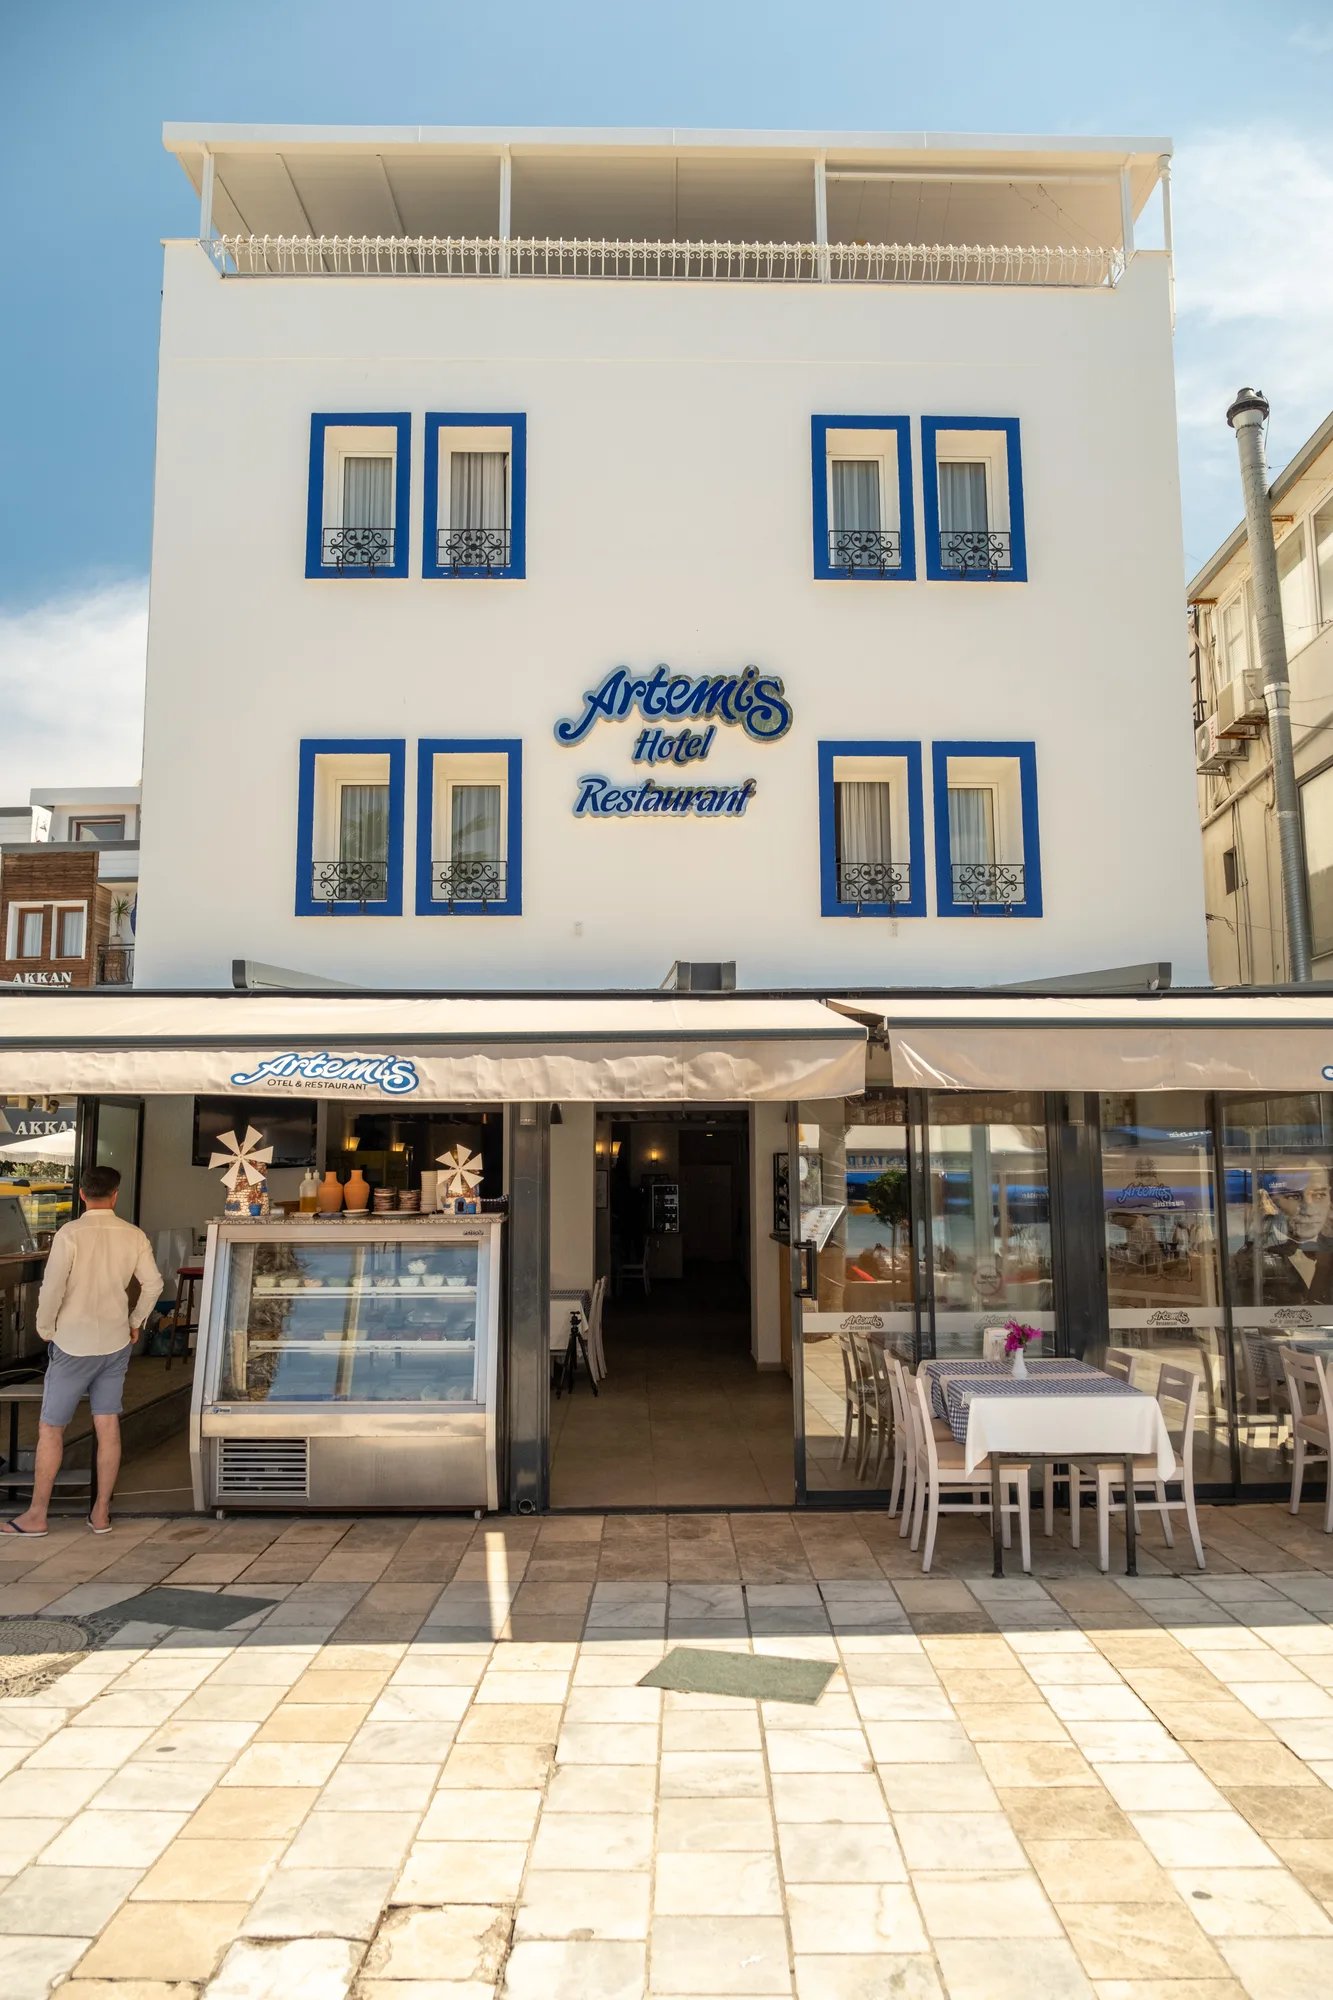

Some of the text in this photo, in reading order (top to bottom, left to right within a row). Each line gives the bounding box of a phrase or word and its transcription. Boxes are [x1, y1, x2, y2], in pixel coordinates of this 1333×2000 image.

[556, 664, 791, 741] Artemis
[633, 724, 716, 763] Hotel
[575, 778, 756, 814] Restaurant
[12, 971, 73, 984] AKKAN
[231, 1052, 419, 1094] Artemis
[267, 1078, 368, 1091] OTEL & RESTAURANT
[1117, 1182, 1173, 1204] Artemis
[840, 1314, 884, 1329] Artemis
[1147, 1310, 1190, 1325] Artemis
